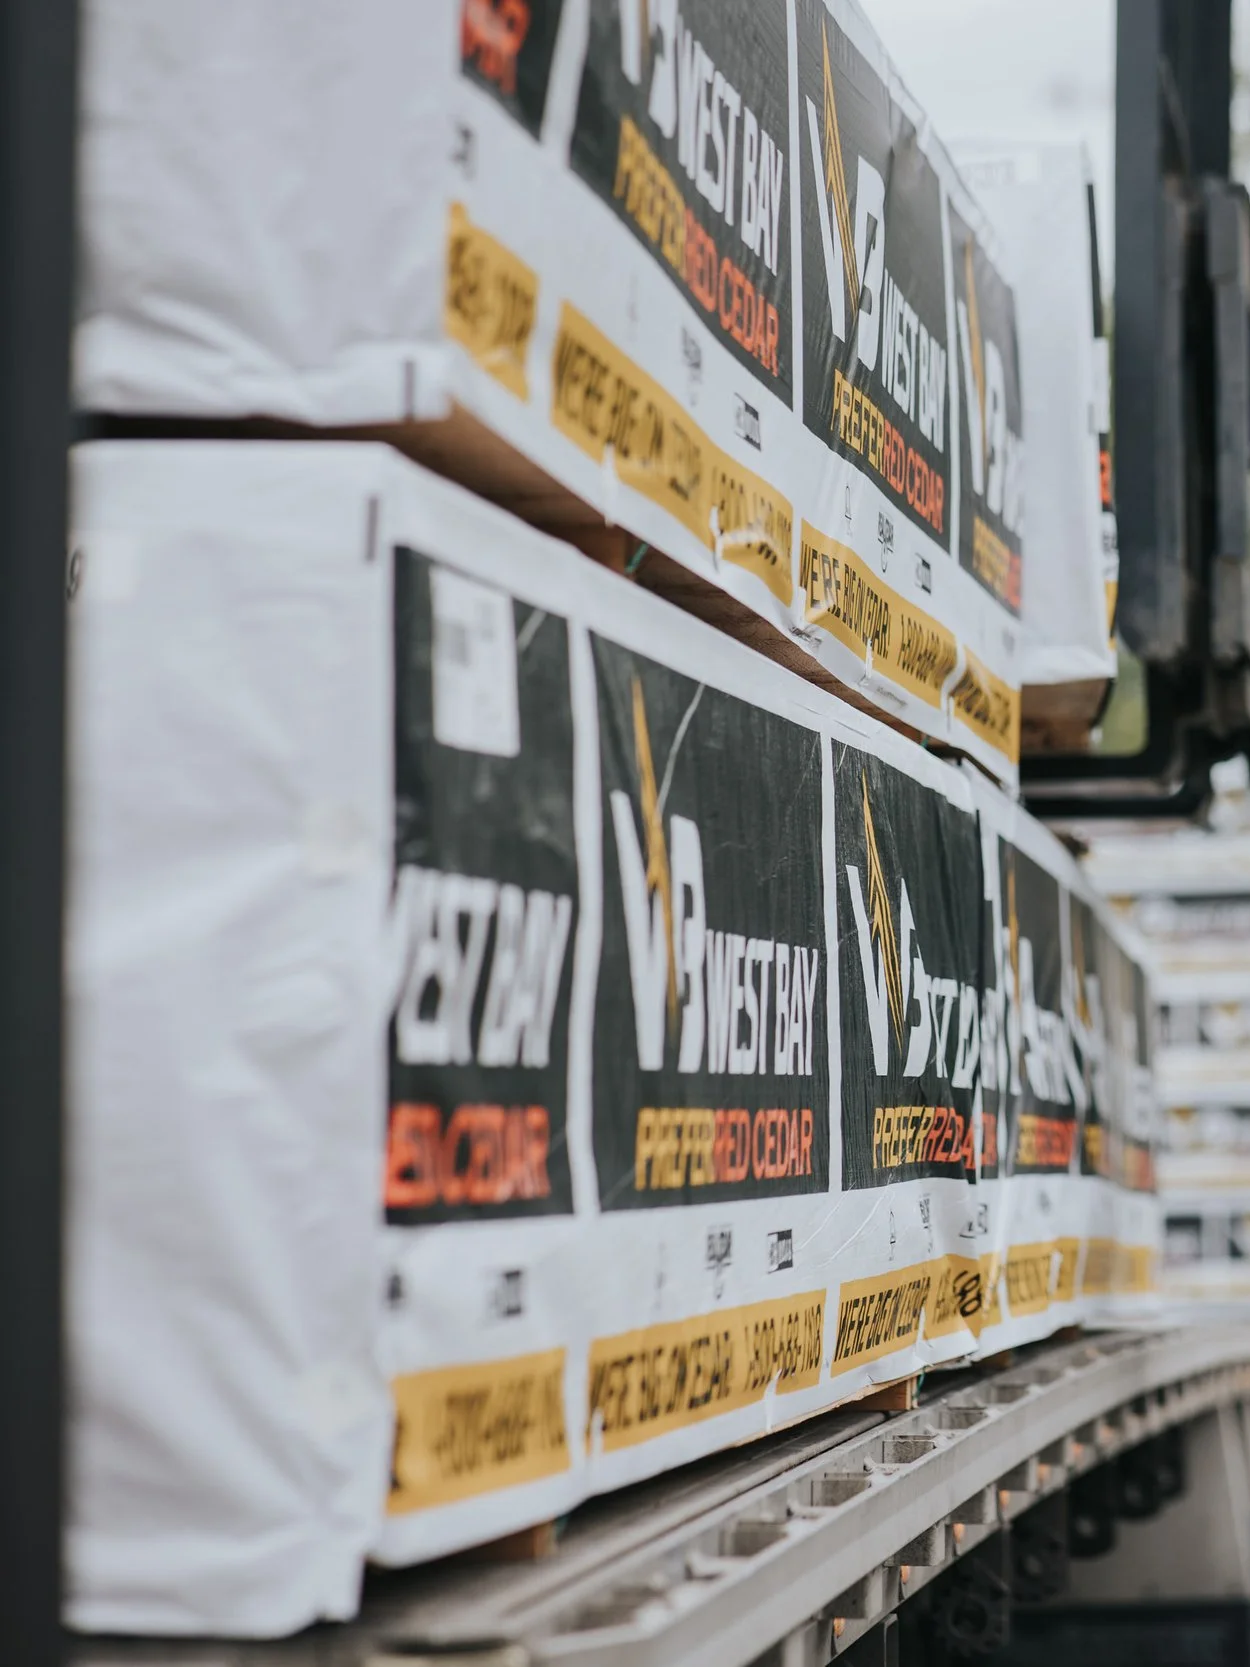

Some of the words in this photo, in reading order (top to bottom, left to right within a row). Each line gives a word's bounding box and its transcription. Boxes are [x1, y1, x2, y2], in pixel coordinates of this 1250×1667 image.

[676, 13, 741, 227] WEST
[740, 105, 784, 278] BAY
[718, 256, 779, 377] CEDAR
[906, 446, 945, 535] CEDAR
[705, 928, 775, 1075] WEST
[774, 942, 819, 1076] BAY
[751, 1107, 814, 1182] CEDAR
